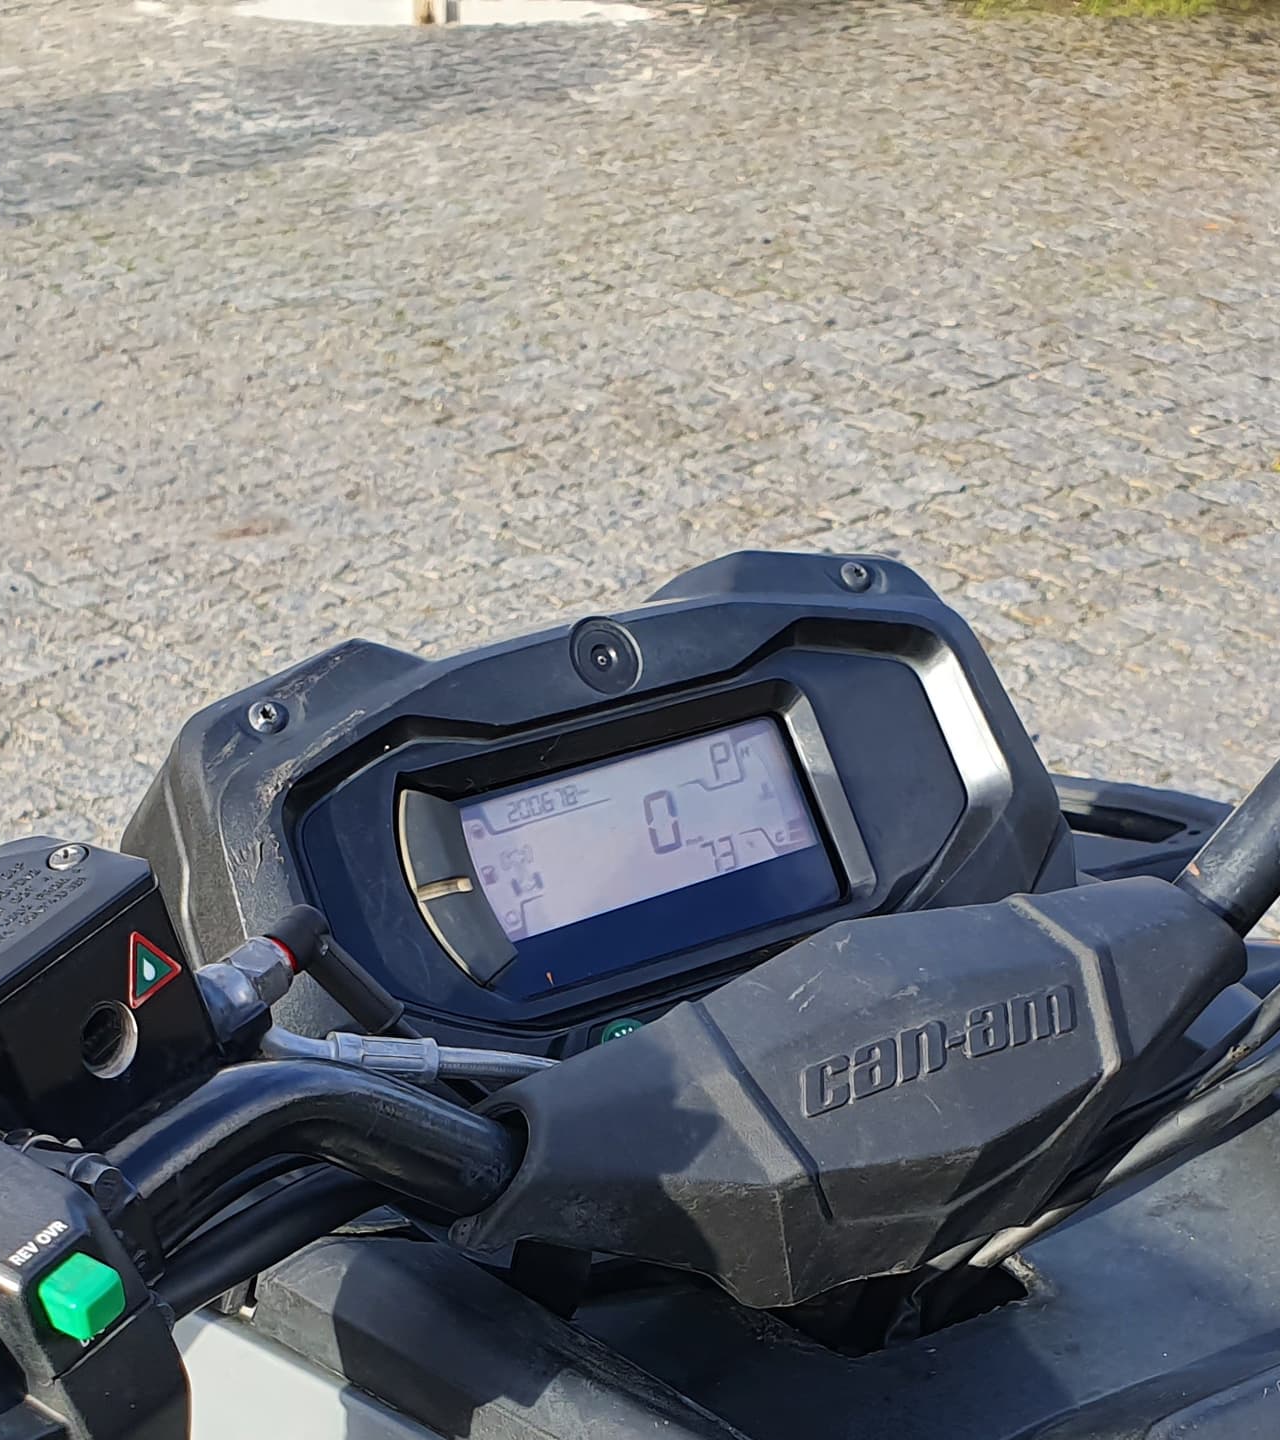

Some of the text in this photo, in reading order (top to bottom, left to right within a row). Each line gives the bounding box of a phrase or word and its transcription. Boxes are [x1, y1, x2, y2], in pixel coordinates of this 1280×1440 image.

[709, 741, 730, 780] P
[644, 790, 682, 854] 0
[801, 984, 1078, 1118] can-am
[8, 1220, 69, 1266] REV OVR
